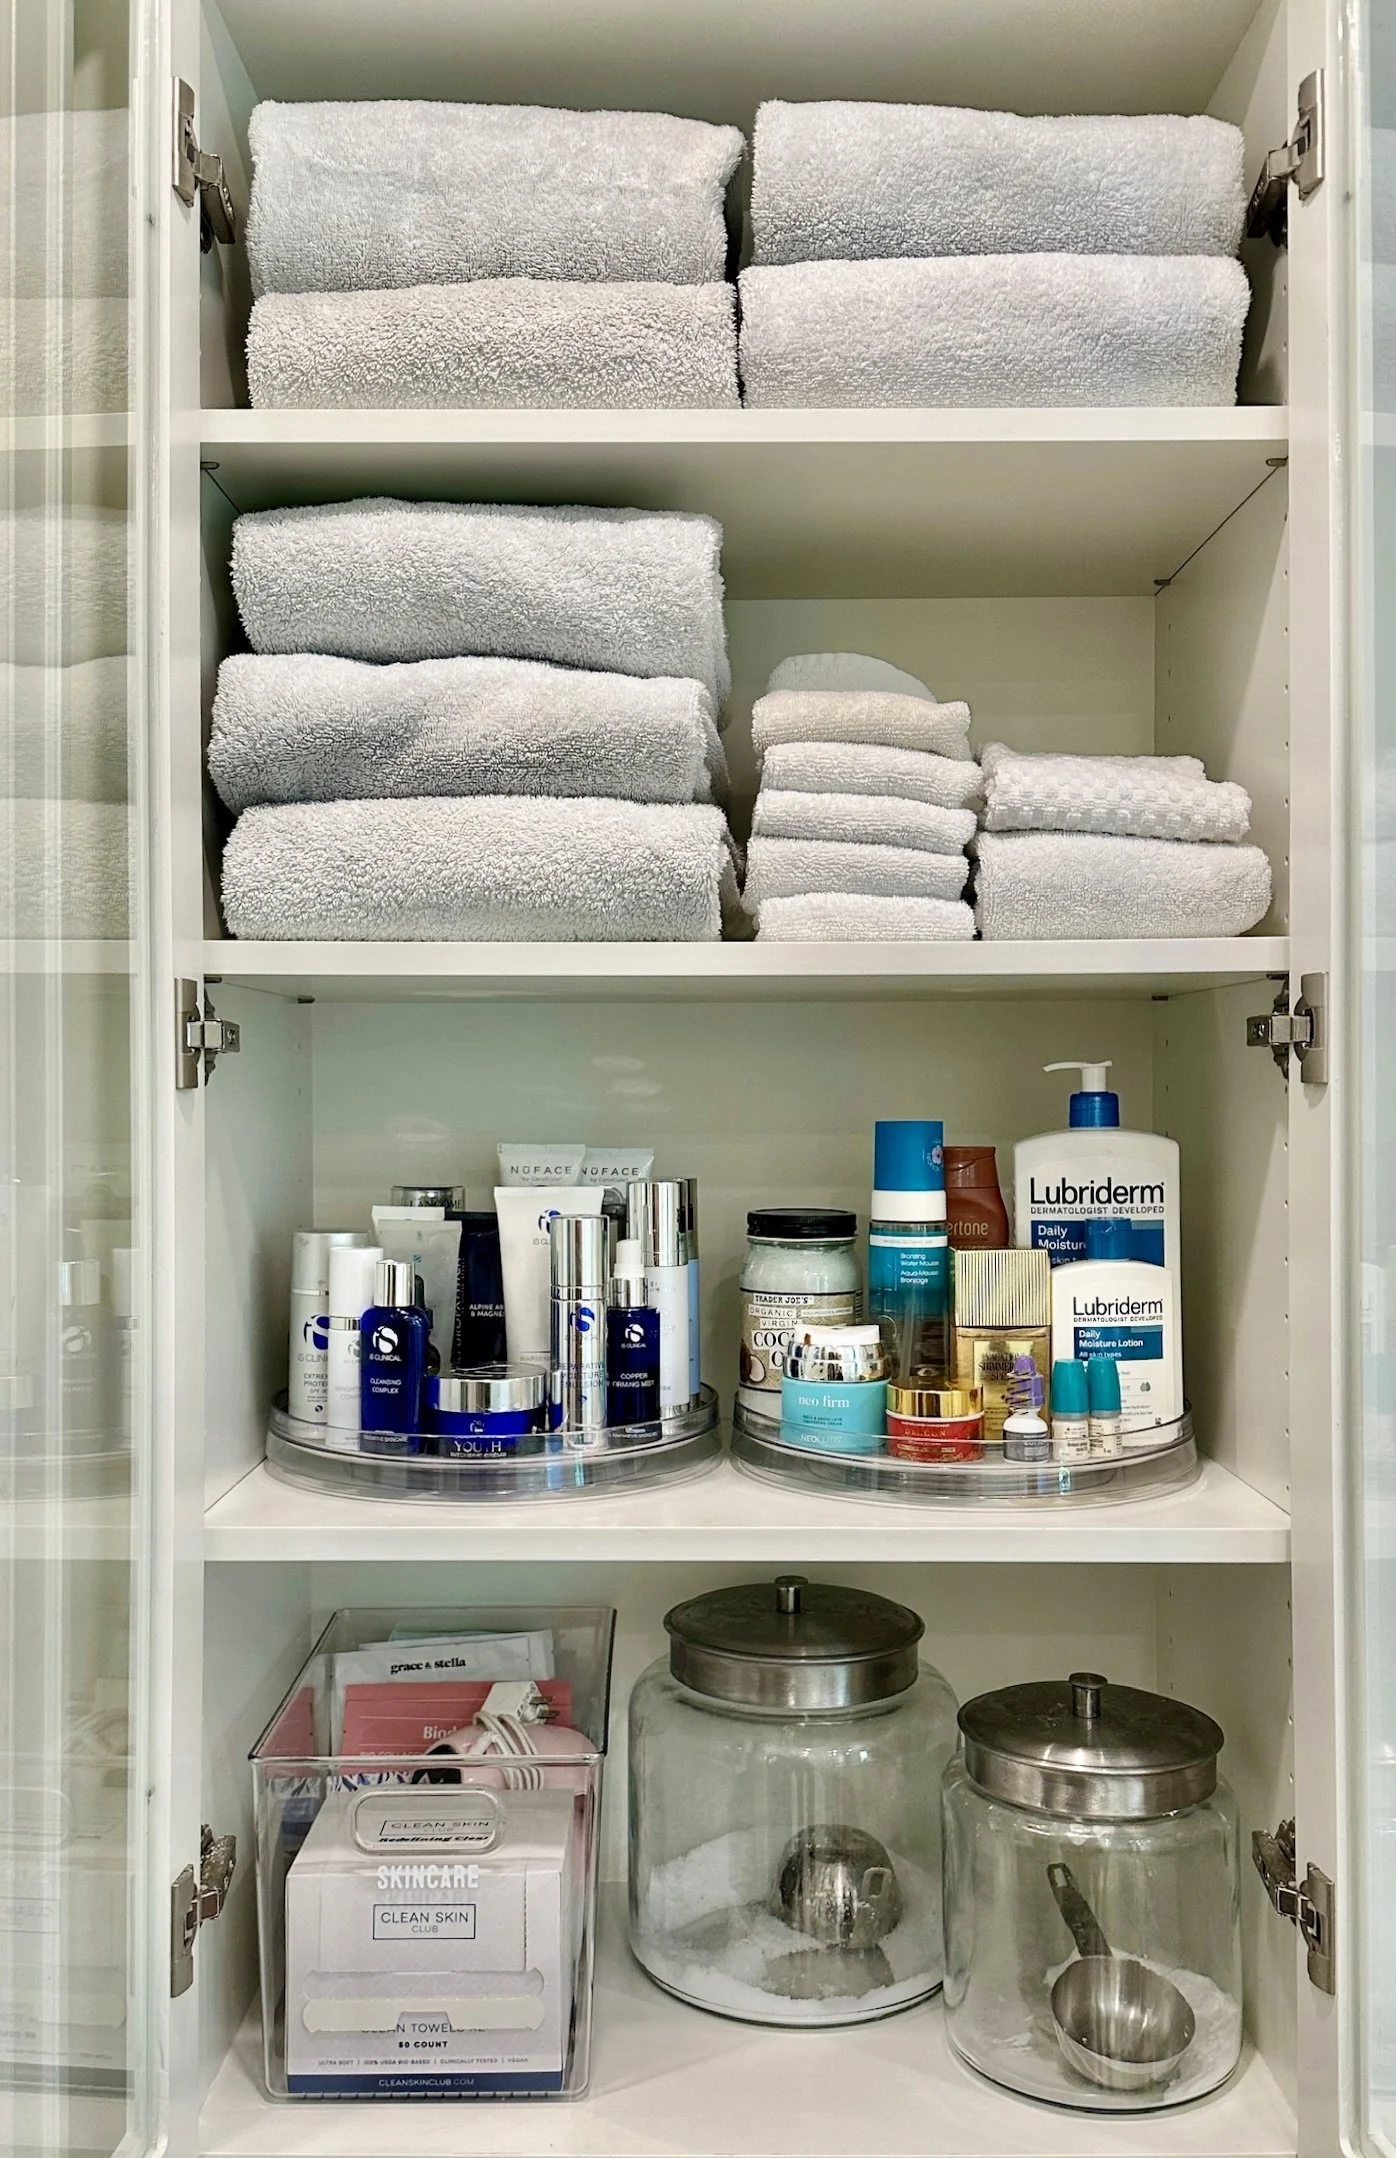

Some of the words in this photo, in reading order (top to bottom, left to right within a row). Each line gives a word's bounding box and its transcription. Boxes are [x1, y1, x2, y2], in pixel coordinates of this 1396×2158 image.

[1030, 1177, 1164, 1205] Lubriderm
[1030, 1206, 1108, 1215] DERMATOLOGIST
[1112, 1205, 1165, 1214] DEVELOPED
[1038, 1225, 1068, 1239] Daily
[755, 1295, 783, 1304] TRADER
[1073, 1296, 1163, 1316] Lubriderm
[749, 1307, 794, 1317] ORGANIC
[753, 1331, 795, 1347] COC
[1079, 1330, 1100, 1340] Daily
[1079, 1340, 1117, 1348] Moisture
[1118, 1339, 1144, 1347] Lotion
[799, 1396, 819, 1406] neo
[823, 1395, 850, 1408] firm
[454, 1441, 501, 1452] YOUH
[390, 1663, 423, 1675] grace
[434, 1657, 466, 1668] stella
[377, 1864, 479, 1889] SKINCARE
[381, 1912, 430, 1923] CLEAN
[435, 1912, 469, 1923] SKIN
[411, 1925, 439, 1933] CLUB
